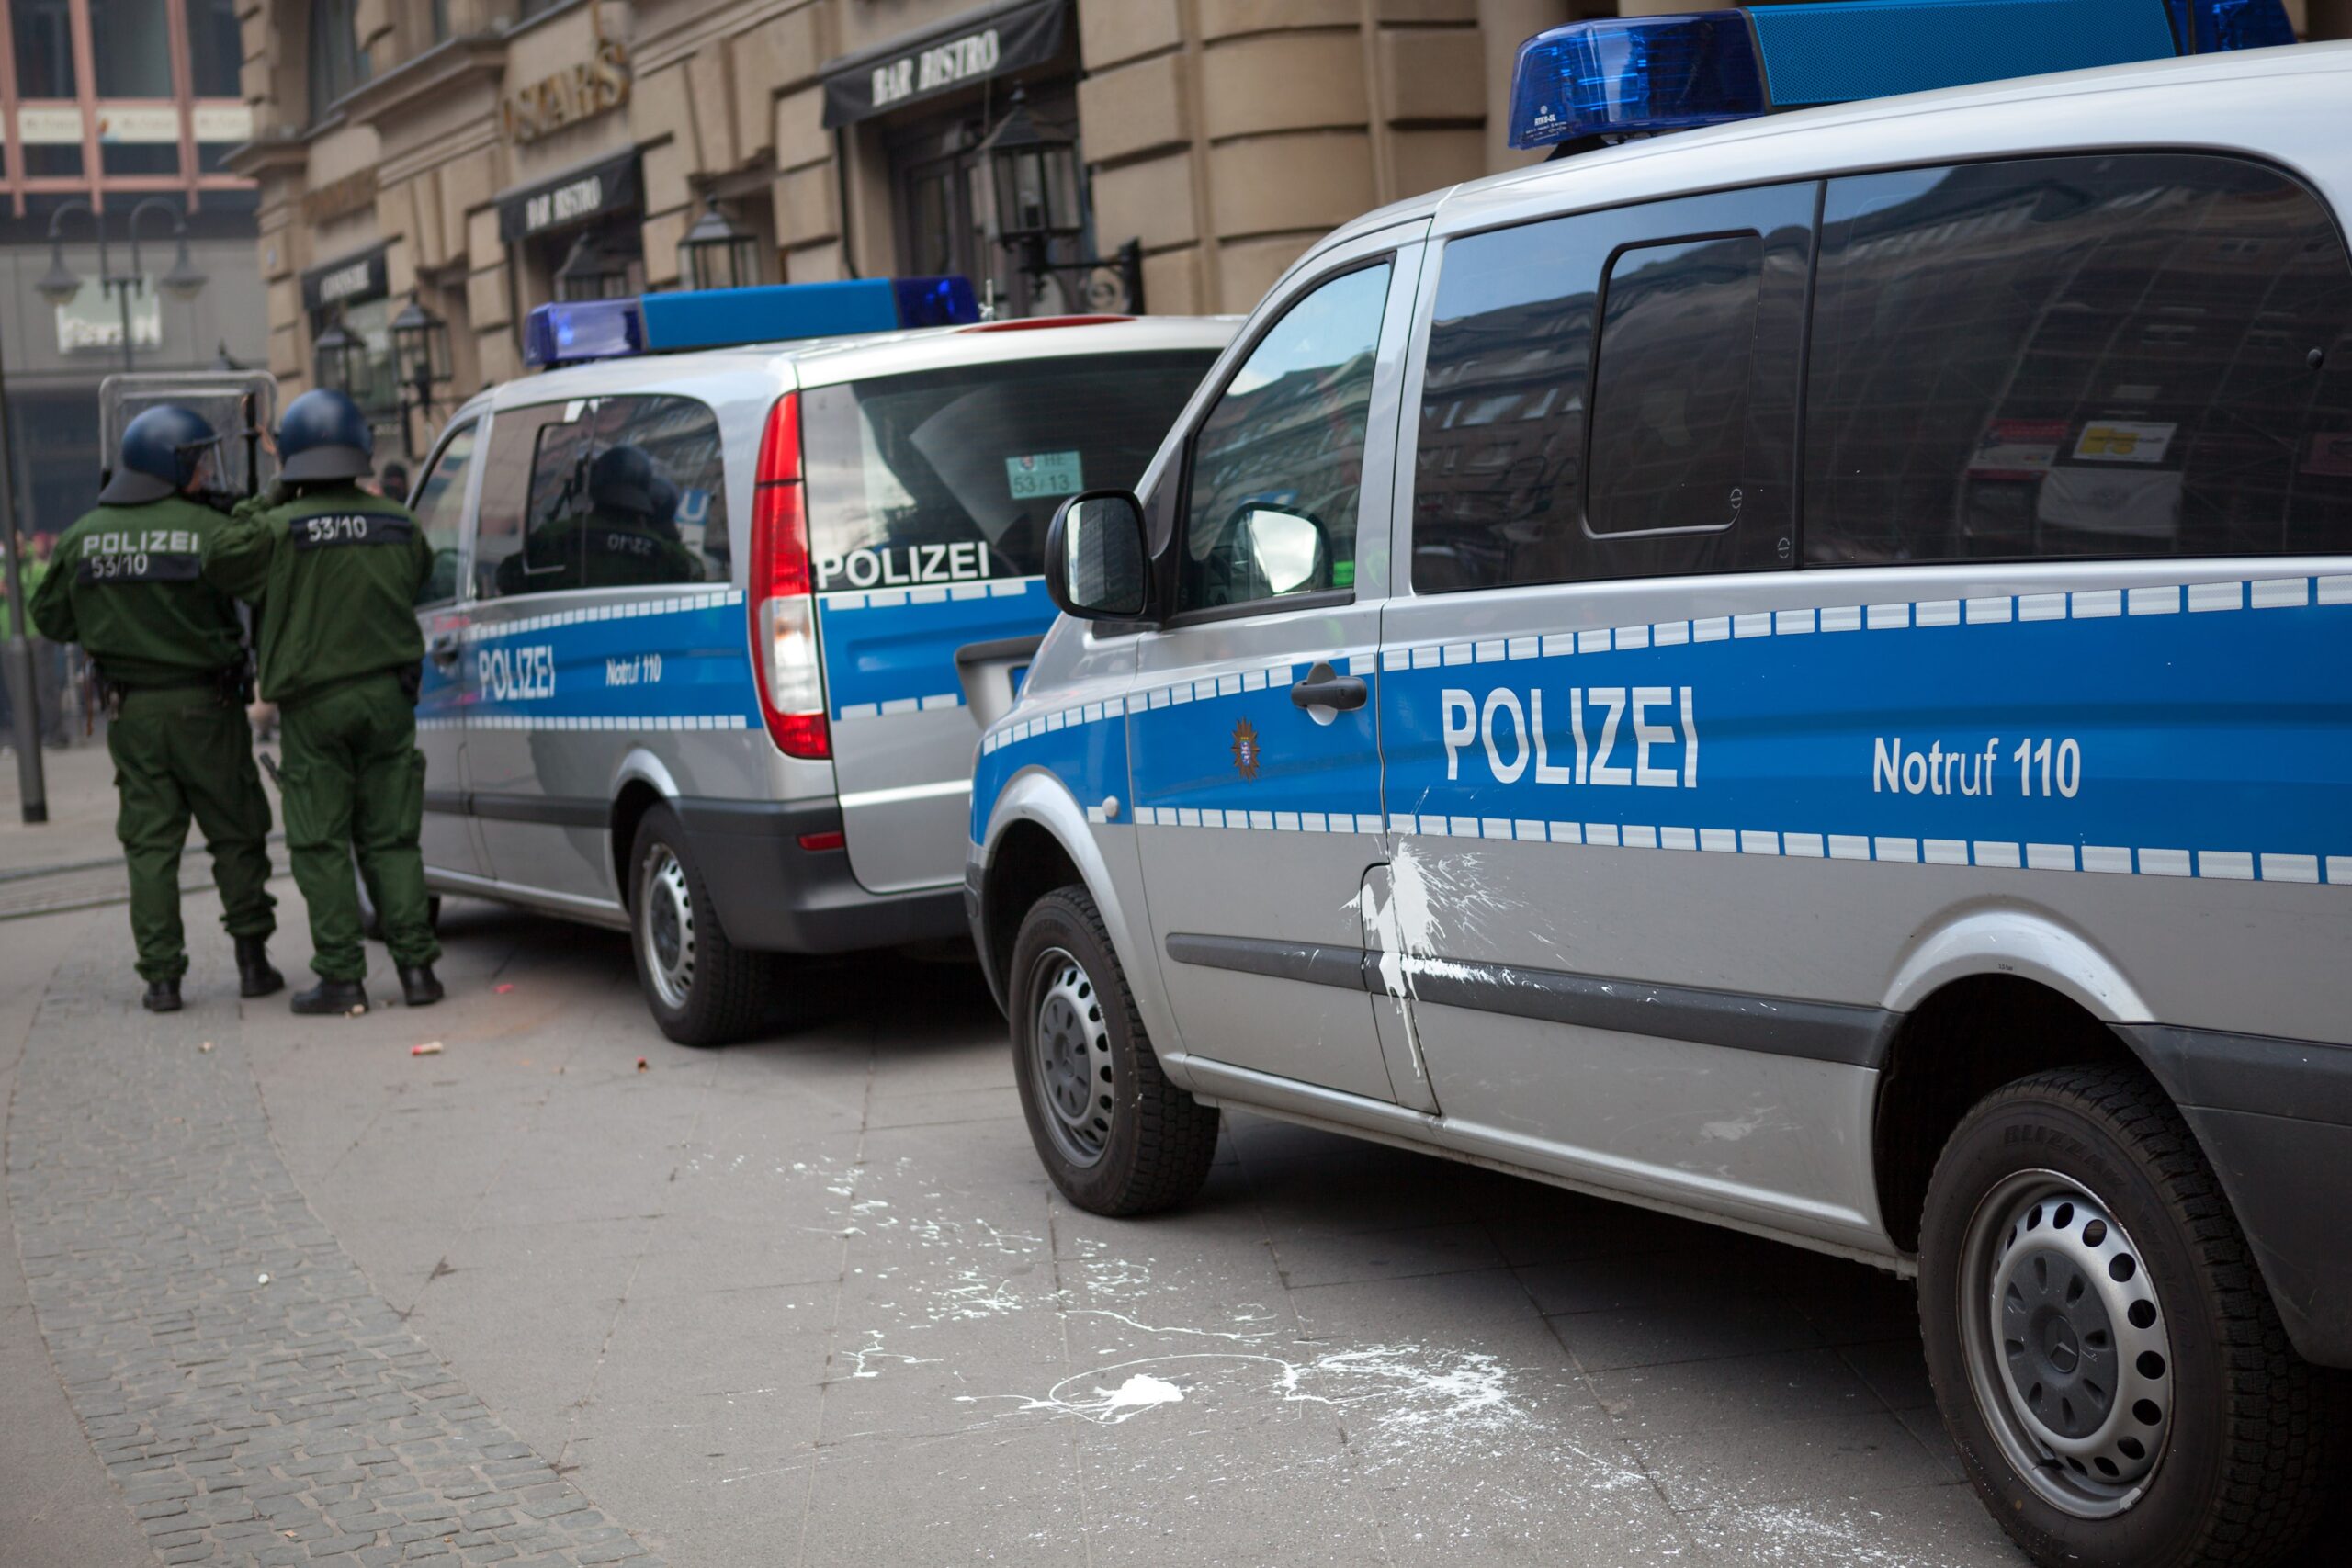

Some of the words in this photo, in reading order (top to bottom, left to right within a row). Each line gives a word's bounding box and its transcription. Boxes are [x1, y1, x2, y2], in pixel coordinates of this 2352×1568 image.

[872, 58, 913, 107] BAR
[918, 29, 1000, 90] BISTRO
[83, 530, 198, 557] POLIZEI
[308, 515, 367, 542] 53/10
[92, 554, 148, 579] 53/10
[815, 541, 991, 591] POLIZEI
[479, 645, 555, 702] POLIZEI
[605, 656, 639, 687] Notruf
[643, 654, 662, 683] 110
[1442, 686, 1697, 788] POLIZEI
[1872, 738, 1998, 798] Notruf
[2013, 738, 2081, 799] 110
[2004, 1123, 2126, 1187] BLIZZAK
